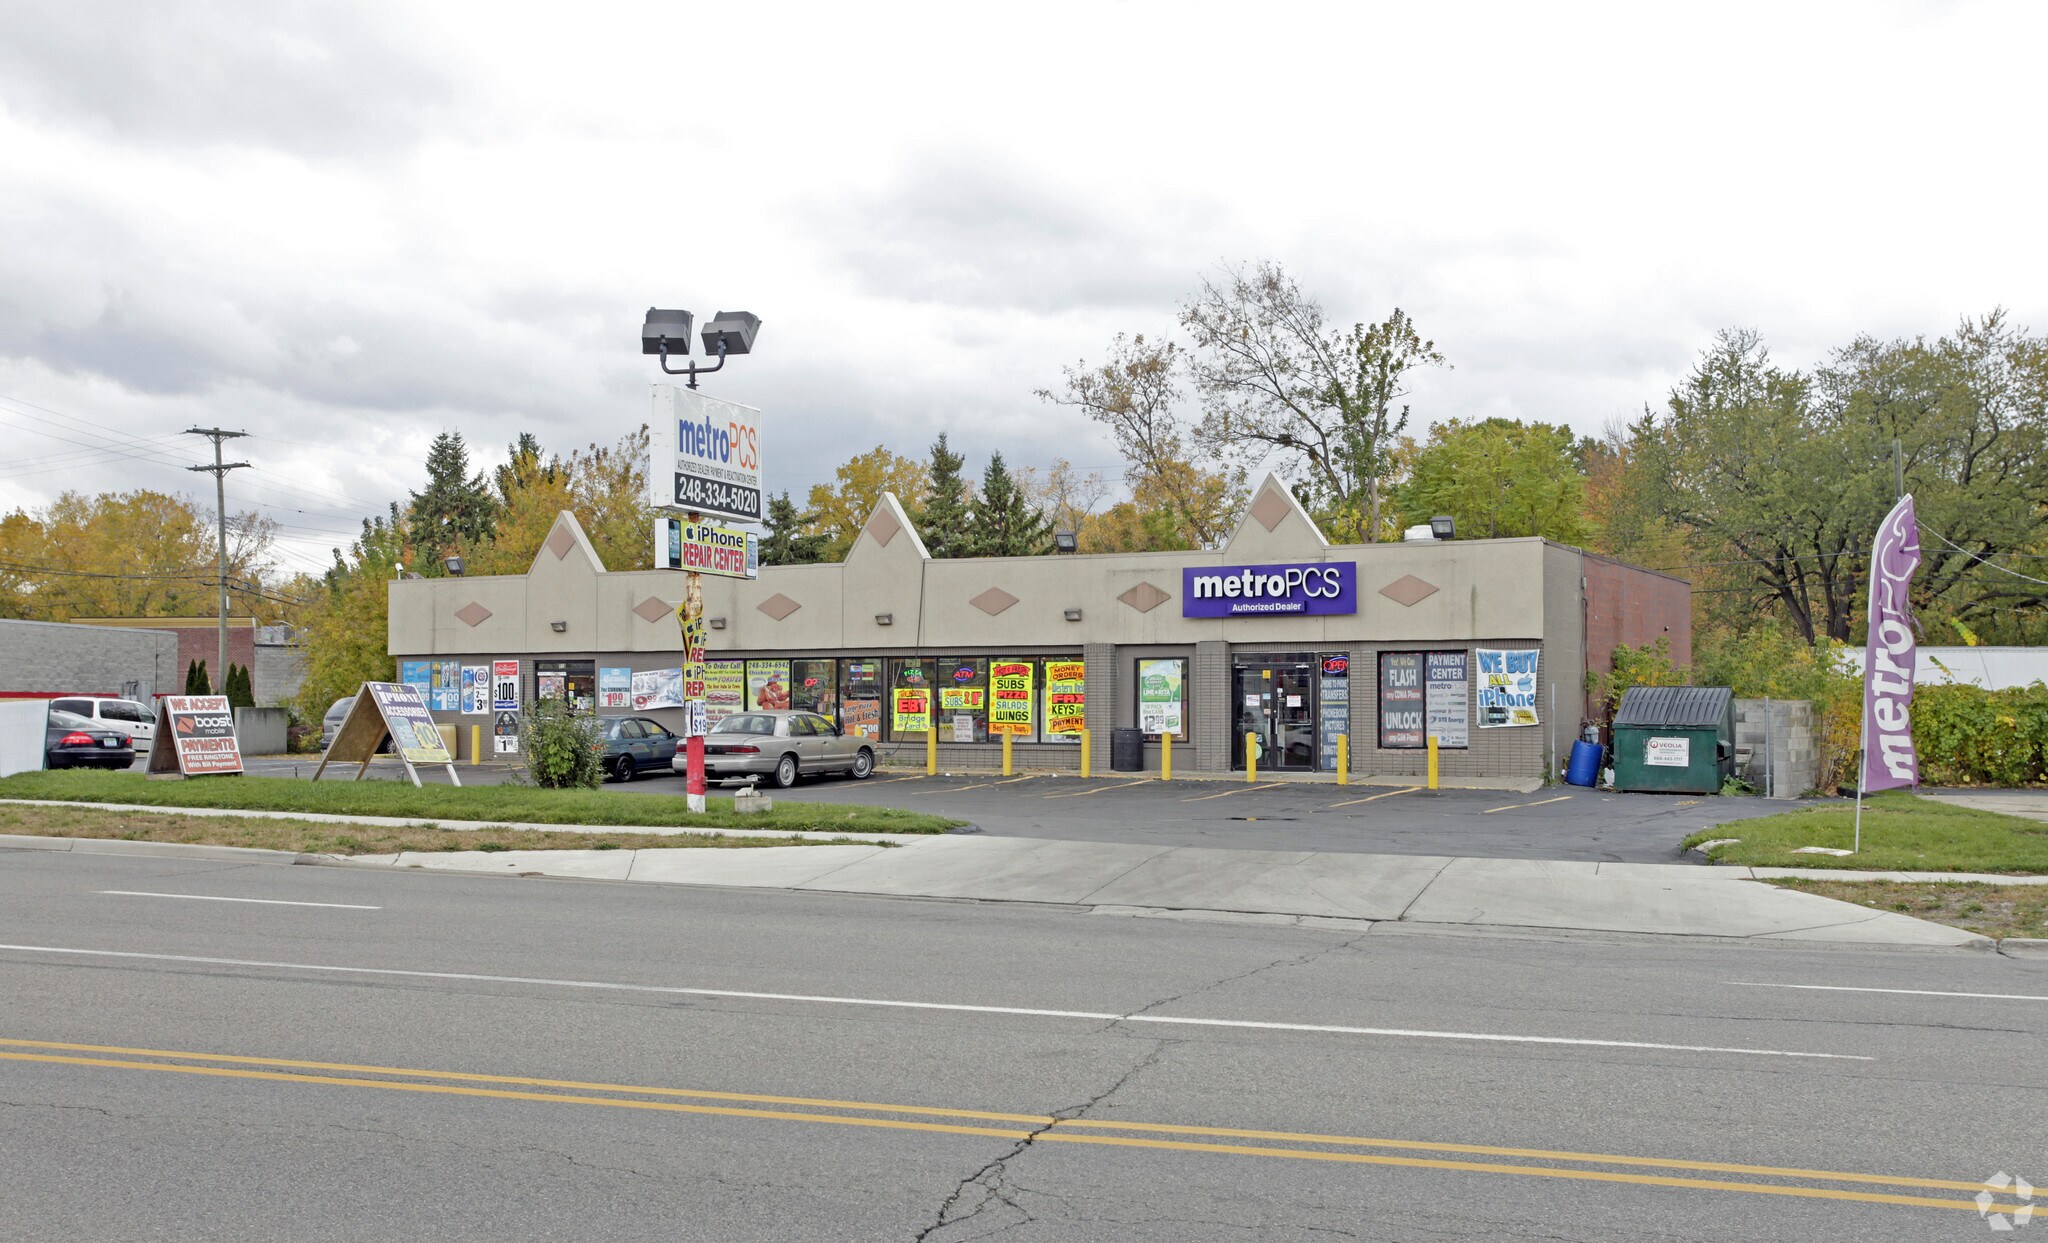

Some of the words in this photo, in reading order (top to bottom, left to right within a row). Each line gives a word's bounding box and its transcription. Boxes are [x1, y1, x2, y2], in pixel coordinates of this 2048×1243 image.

[679, 416, 757, 470] metroPCS
[678, 460, 696, 473] AUTHORIZED
[698, 464, 710, 476] DEALER
[710, 467, 724, 478] PAYMENT
[747, 475, 757, 486] CENTER
[679, 477, 757, 513] 248-334-5020
[698, 526, 743, 547] iPhone
[683, 542, 712, 568] REPAIR
[714, 547, 744, 572] CENTER
[1194, 567, 1340, 598] metroPCS
[690, 648, 705, 662] RE
[1428, 655, 1465, 665] PAYMENT
[1323, 660, 1348, 670] OPEN
[1477, 652, 1503, 673] WE
[1506, 652, 1537, 674] BUY
[1389, 669, 1416, 686] FLASH
[1431, 668, 1463, 679] CENTER
[997, 680, 1024, 689] SUBS
[1489, 674, 1512, 685] ALL
[686, 681, 705, 696] REP
[1052, 683, 1072, 692] Western
[997, 690, 1028, 699] PIZZA
[1052, 694, 1084, 704] FAX
[1322, 689, 1348, 699] TRANSFERS
[1479, 687, 1535, 706] iPhone
[170, 698, 188, 711] WE
[190, 697, 227, 710] ACCEPT
[897, 698, 927, 713] EBT
[945, 697, 963, 706] SUBS
[996, 702, 1028, 710] SALADS
[384, 706, 427, 717] ACCESSORIES
[863, 709, 878, 720] Fresh
[1052, 705, 1074, 714] KEYS
[1322, 708, 1348, 718] PHONEBOOK
[194, 715, 232, 727] boost
[996, 711, 1028, 720] WINGS
[1386, 712, 1422, 729] UNLOCK
[1053, 718, 1083, 727] PAYMENT
[1325, 720, 1345, 730] PICTURES
[1327, 733, 1338, 742] VIDE
[181, 738, 236, 752] PAYMENTS
